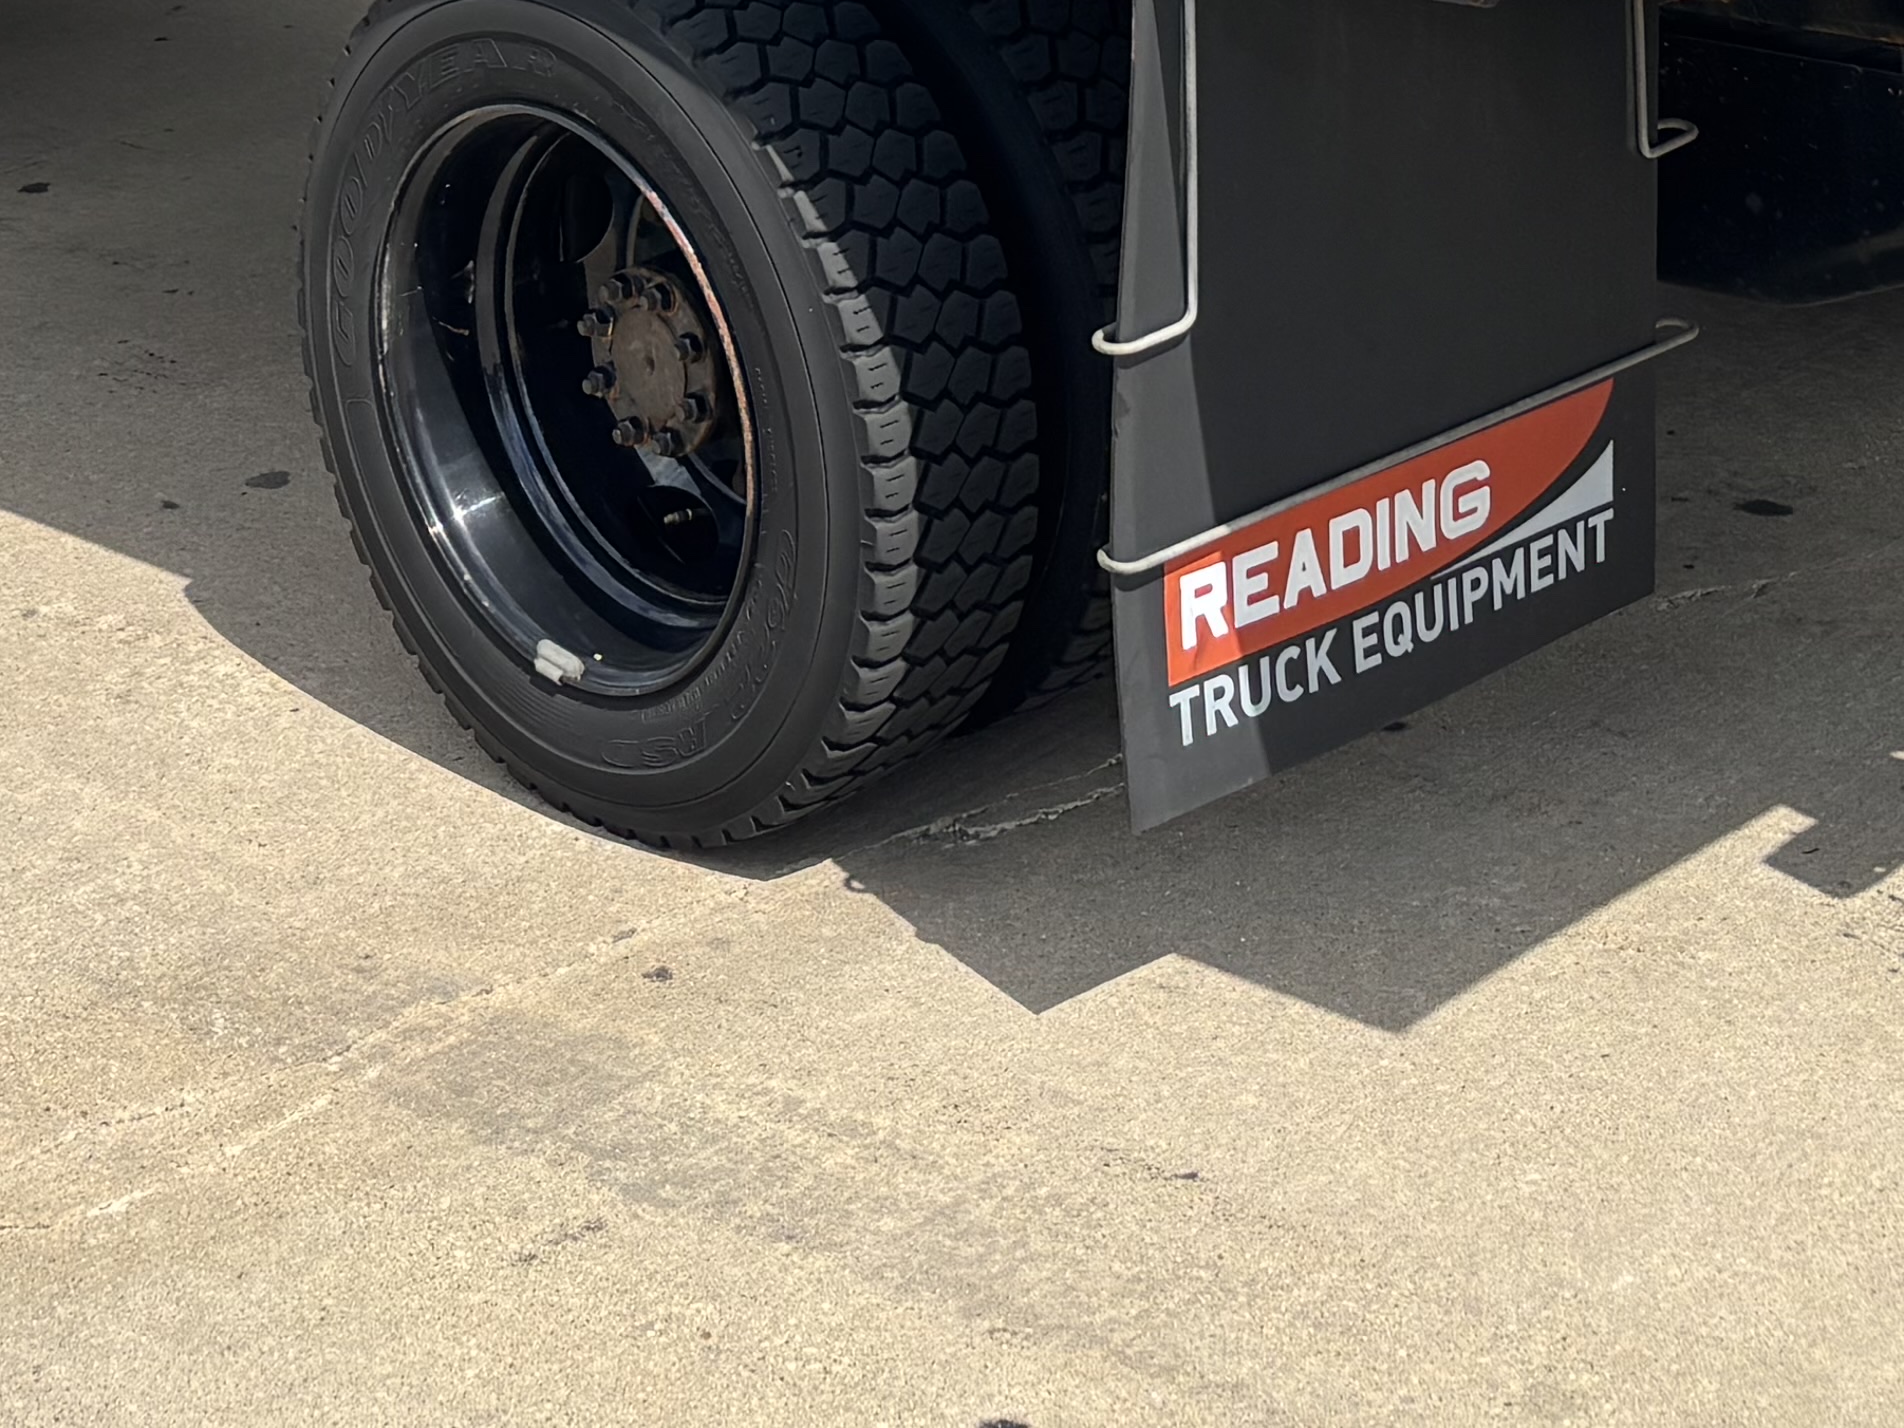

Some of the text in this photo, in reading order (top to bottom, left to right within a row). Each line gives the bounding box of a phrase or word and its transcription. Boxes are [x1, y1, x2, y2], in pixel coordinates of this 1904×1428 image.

[334, 37, 558, 366] GOODYEAR
[1169, 508, 1614, 746] TRUCK EQUIPMENT
[1179, 460, 1491, 651] READING
